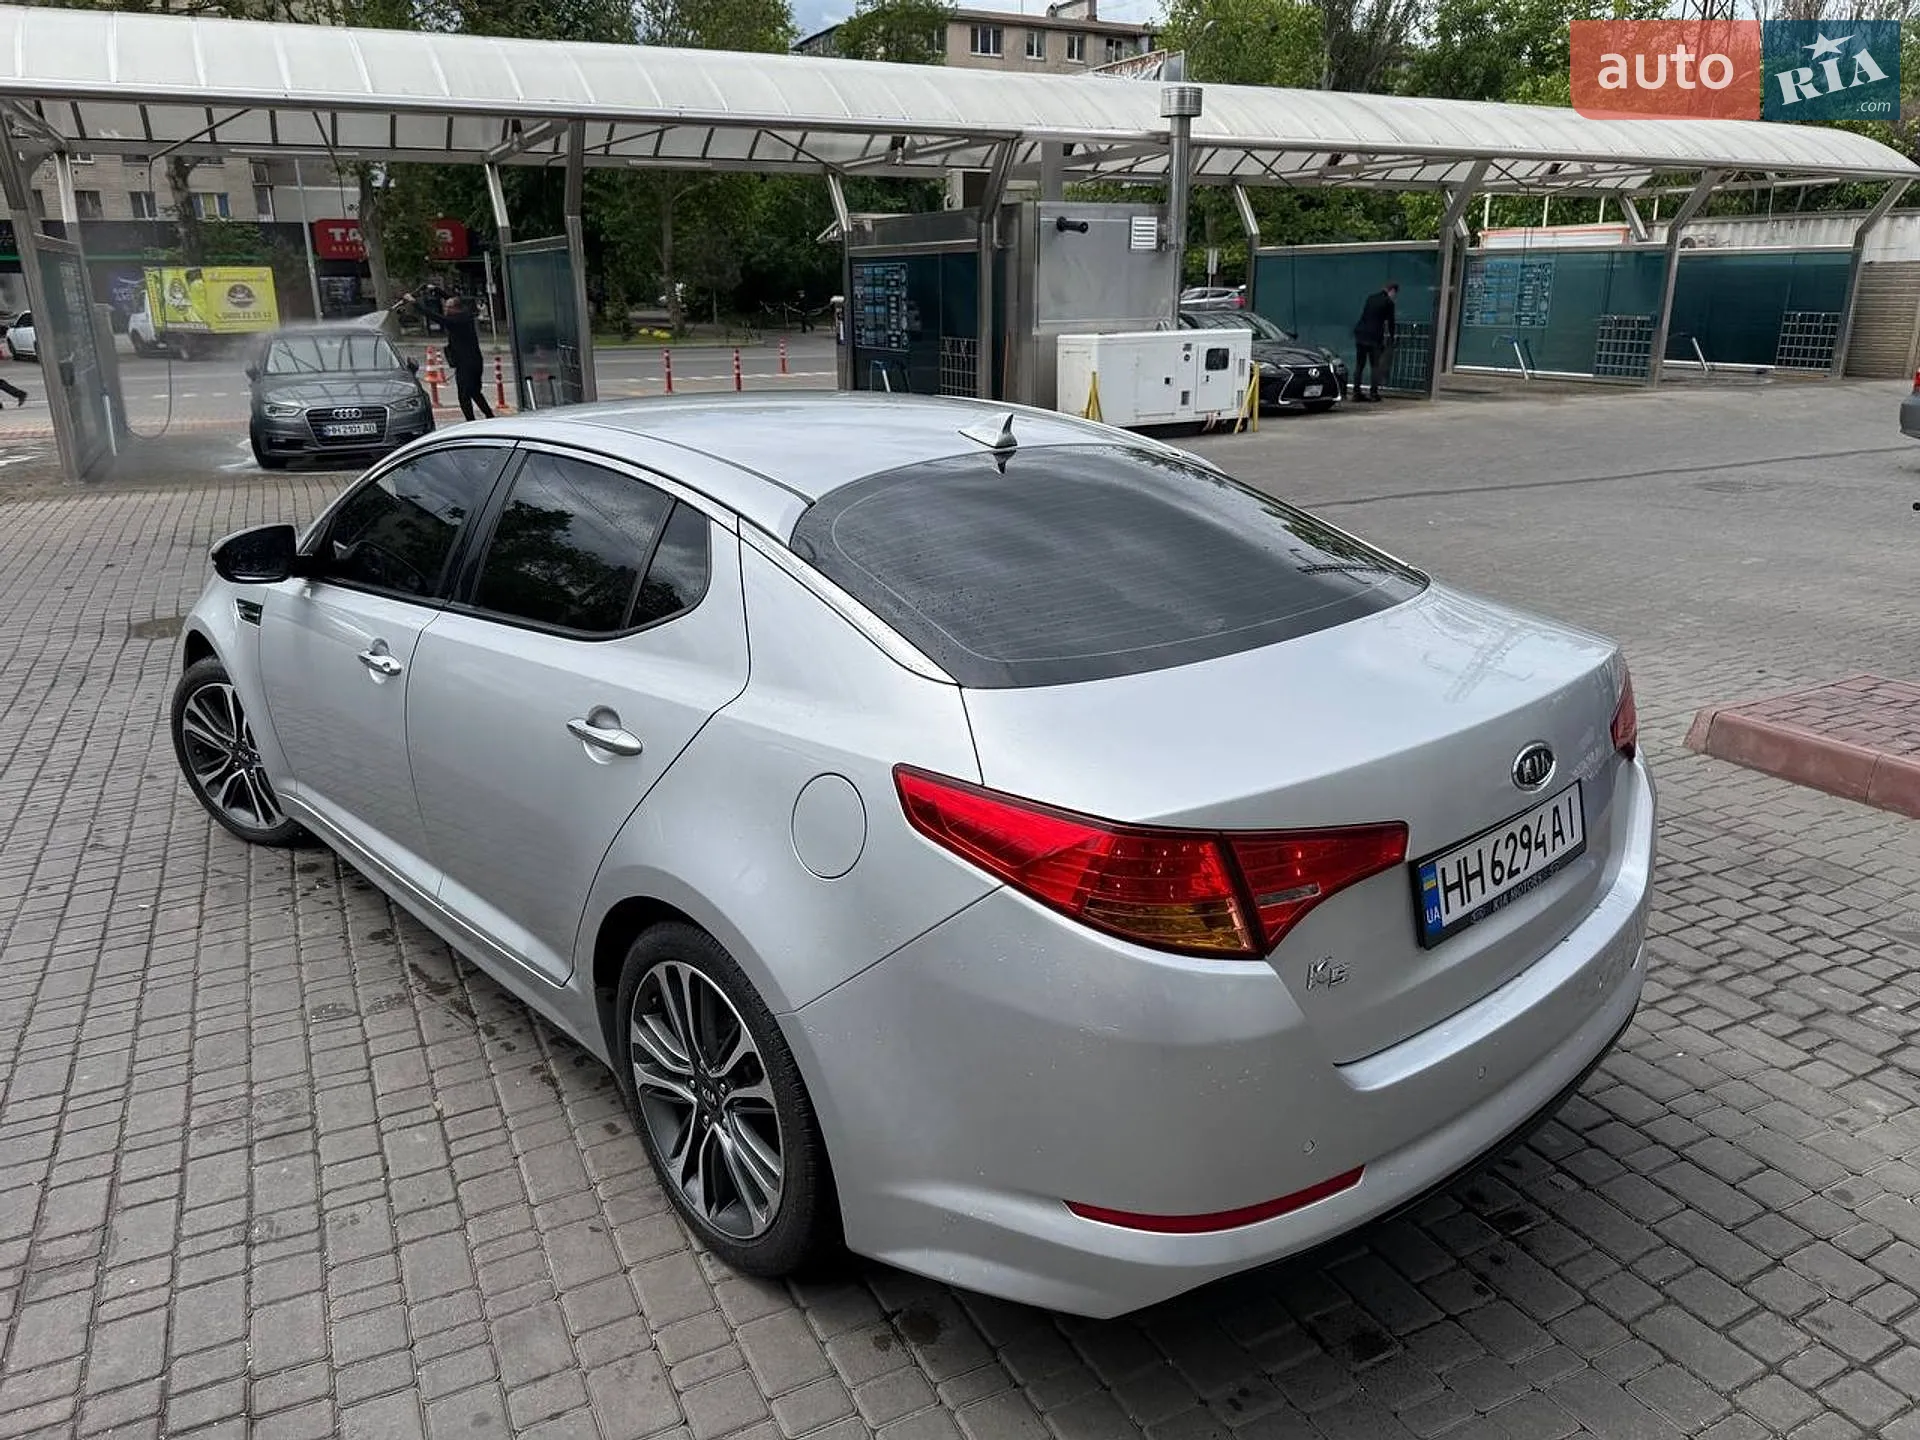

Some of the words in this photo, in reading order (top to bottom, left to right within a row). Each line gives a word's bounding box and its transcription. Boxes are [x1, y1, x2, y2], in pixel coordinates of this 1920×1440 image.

[1520, 752, 1551, 784] KIA
[1441, 848, 1486, 915] HH
[1490, 814, 1548, 886] 6294
[1552, 796, 1575, 852] AI
[1425, 905, 1441, 924] UA
